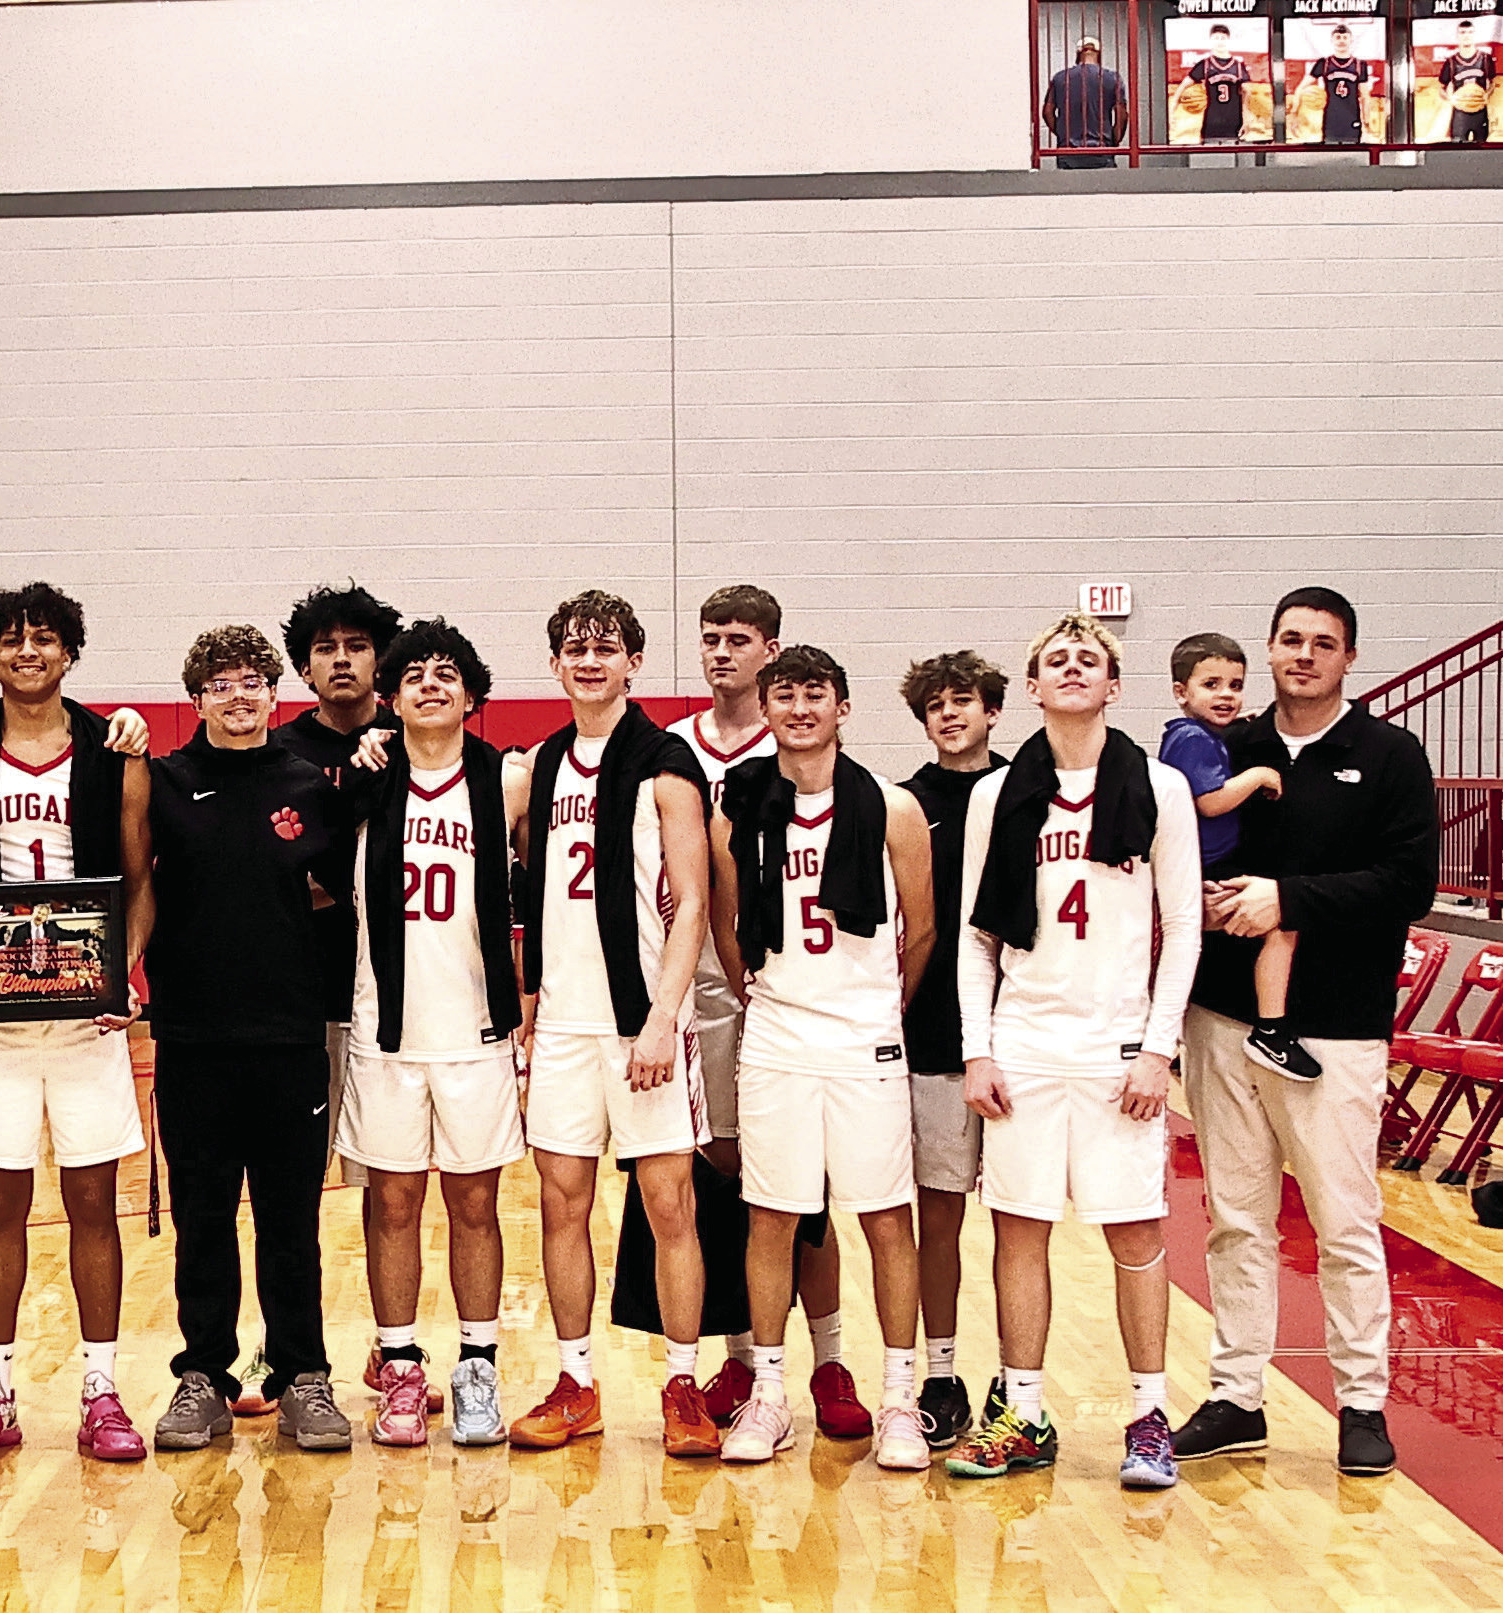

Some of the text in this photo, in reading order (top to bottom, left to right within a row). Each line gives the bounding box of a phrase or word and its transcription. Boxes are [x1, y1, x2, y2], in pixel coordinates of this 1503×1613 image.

[1294, 0, 1319, 13] JACK
[1434, 0, 1497, 13] JACE MYERS
[1217, 83, 1230, 103] 3
[1335, 80, 1348, 98] 4
[1090, 586, 1124, 613] EXIT
[28, 838, 46, 881] 1
[403, 861, 456, 922] 20
[1057, 879, 1090, 940] 4
[800, 895, 834, 955] 5
[39, 951, 82, 961] LARKE
